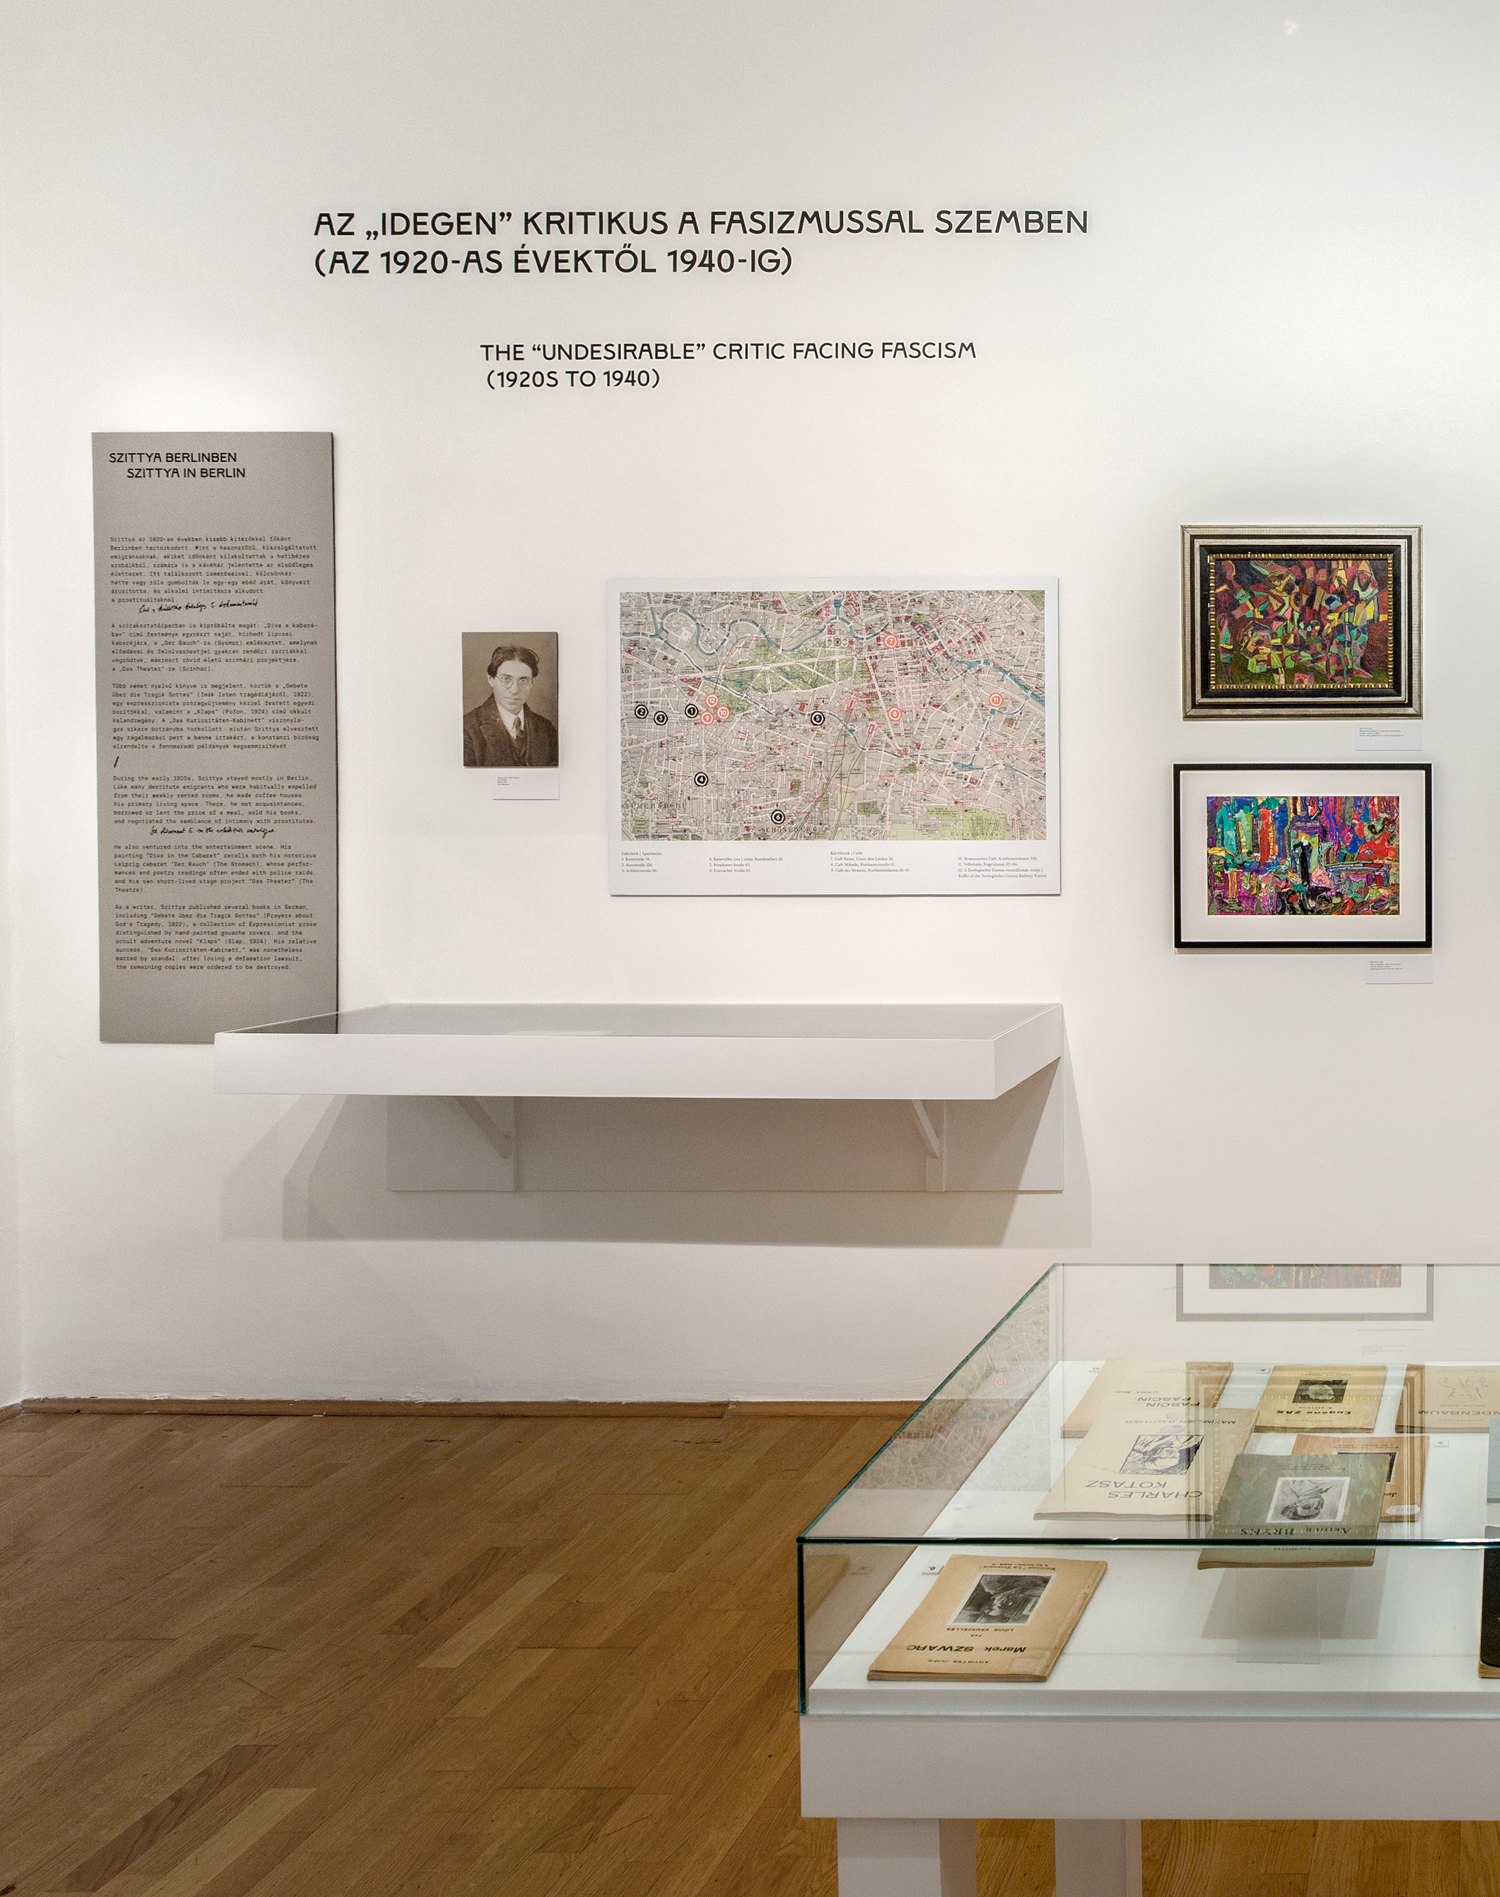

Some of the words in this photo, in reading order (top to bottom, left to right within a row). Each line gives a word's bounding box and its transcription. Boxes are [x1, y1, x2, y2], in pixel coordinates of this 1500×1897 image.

[313, 212, 355, 237] AZ
[523, 210, 669, 236] KRITIKUS
[677, 211, 700, 235] A
[710, 209, 925, 235] FASIZMUSSAL
[934, 209, 1088, 234] SZEMBEN
[314, 248, 370, 278] (AZ
[380, 249, 503, 275] 1920-AS
[513, 247, 657, 274] ÉVEKTŐL
[667, 246, 792, 276] 1940-IG)
[479, 343, 525, 362] THE
[531, 342, 706, 361] “UNDESIRABLE”
[712, 342, 786, 360] CRITIC
[793, 341, 874, 360] FACING
[881, 341, 977, 359] FASCISM
[486, 369, 559, 391] (1920S
[564, 369, 597, 388] TO
[602, 368, 660, 389] 1940)
[108, 452, 163, 464] SZITTYA
[165, 451, 238, 463] BERLINBEN
[126, 467, 181, 479] SZITTYA
[183, 467, 197, 479] IN
[199, 467, 246, 479] BERLIN
[1085, 1480, 1167, 1489] KOTASZ
[1108, 1490, 1203, 1499] CHARLES
